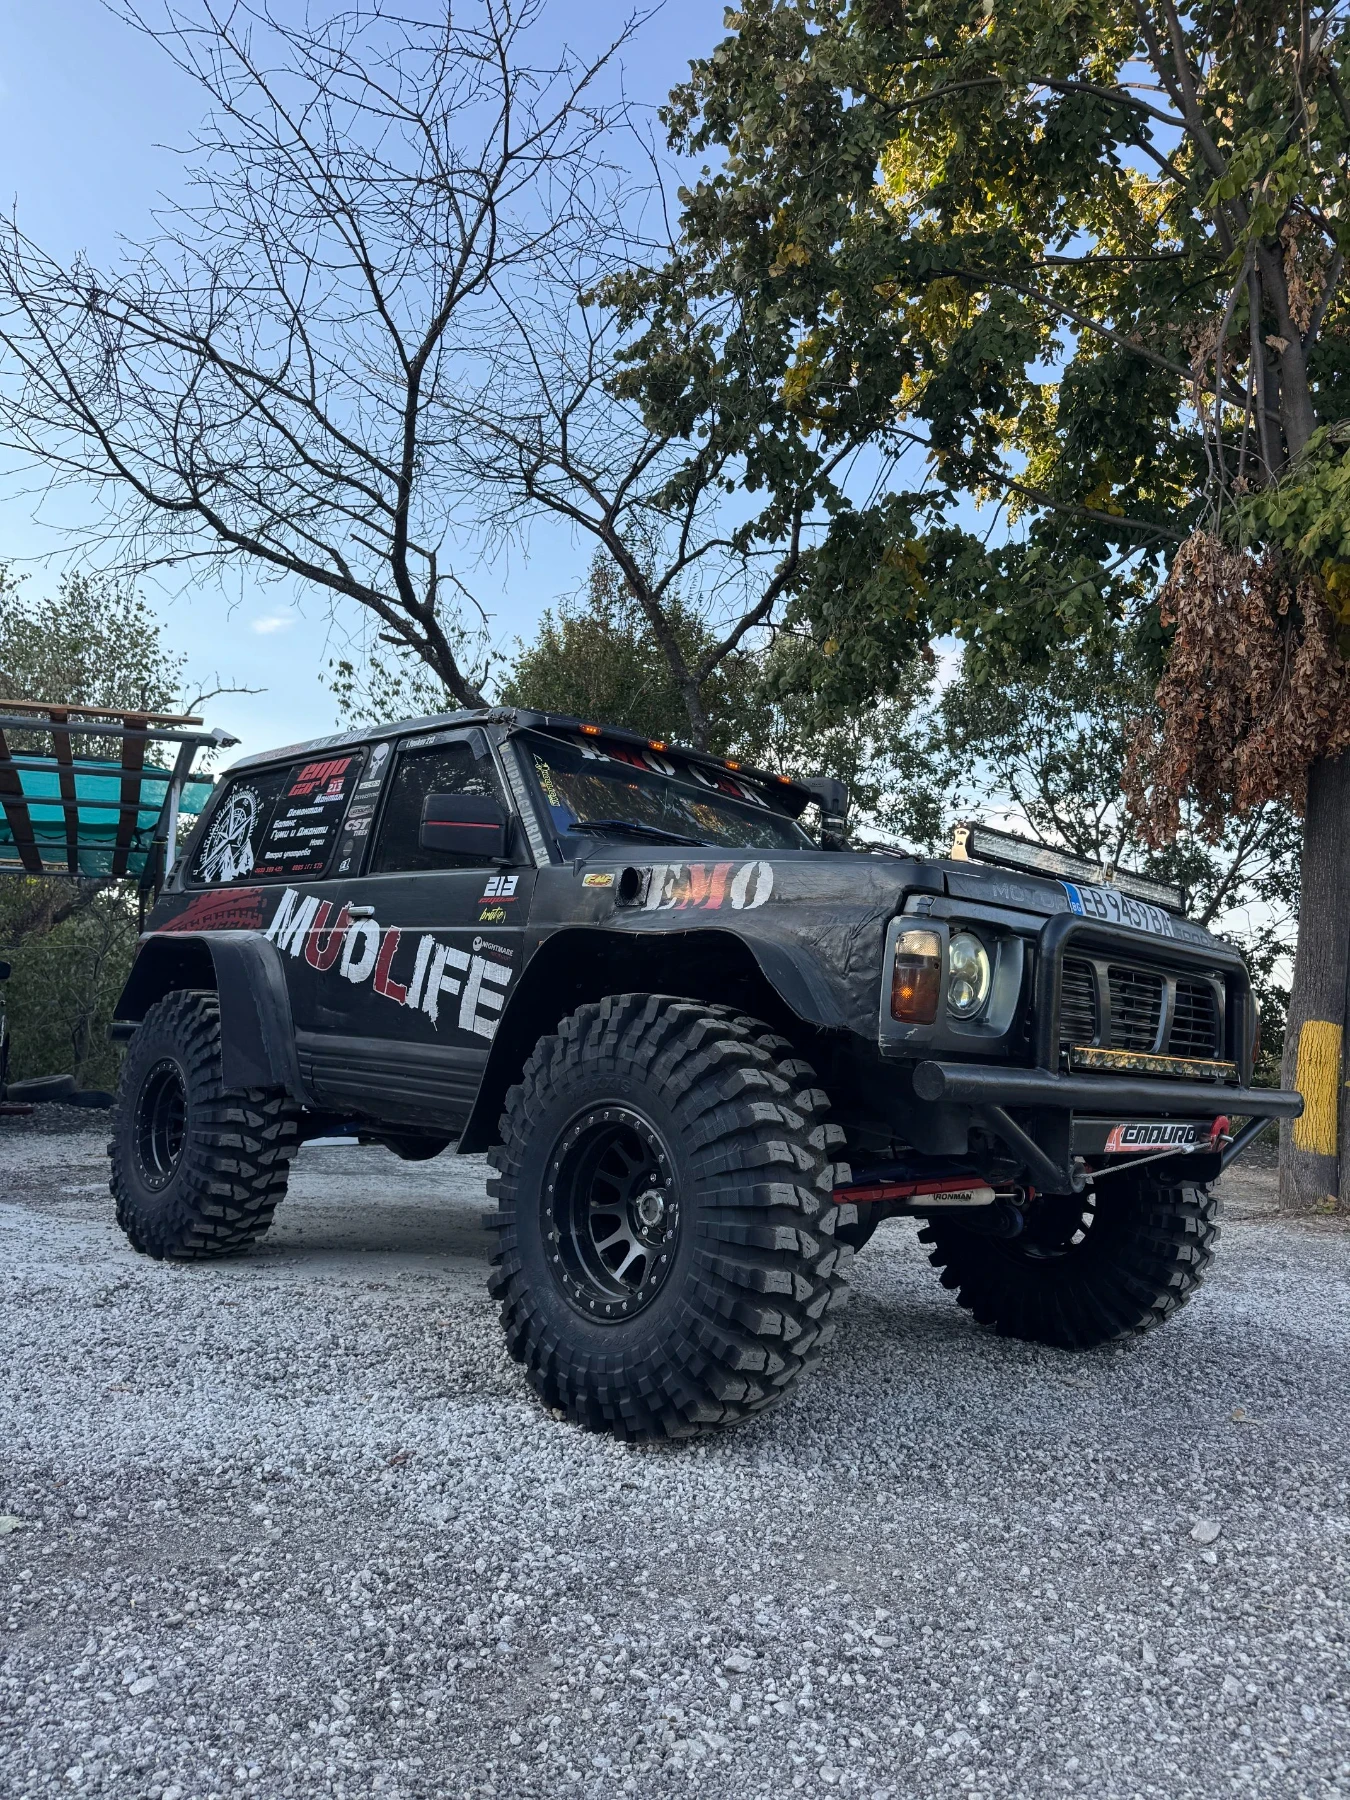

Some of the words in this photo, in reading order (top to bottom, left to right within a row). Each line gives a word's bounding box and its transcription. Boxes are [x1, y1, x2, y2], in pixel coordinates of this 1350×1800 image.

[288, 780, 321, 797] car
[326, 782, 343, 793] 213
[344, 817, 372, 831] CST
[270, 829, 289, 841] Гуми
[289, 829, 296, 838] и
[483, 875, 520, 897] 213
[640, 861, 774, 911] EMO
[1071, 902, 1082, 912] BG
[1078, 886, 1108, 919] EB
[1105, 893, 1150, 931] 9459
[1147, 905, 1171, 937] BA
[482, 940, 514, 957] NIGHTMARE
[264, 887, 514, 1041] MUDLIFE
[1121, 1125, 1198, 1144] ENDURO
